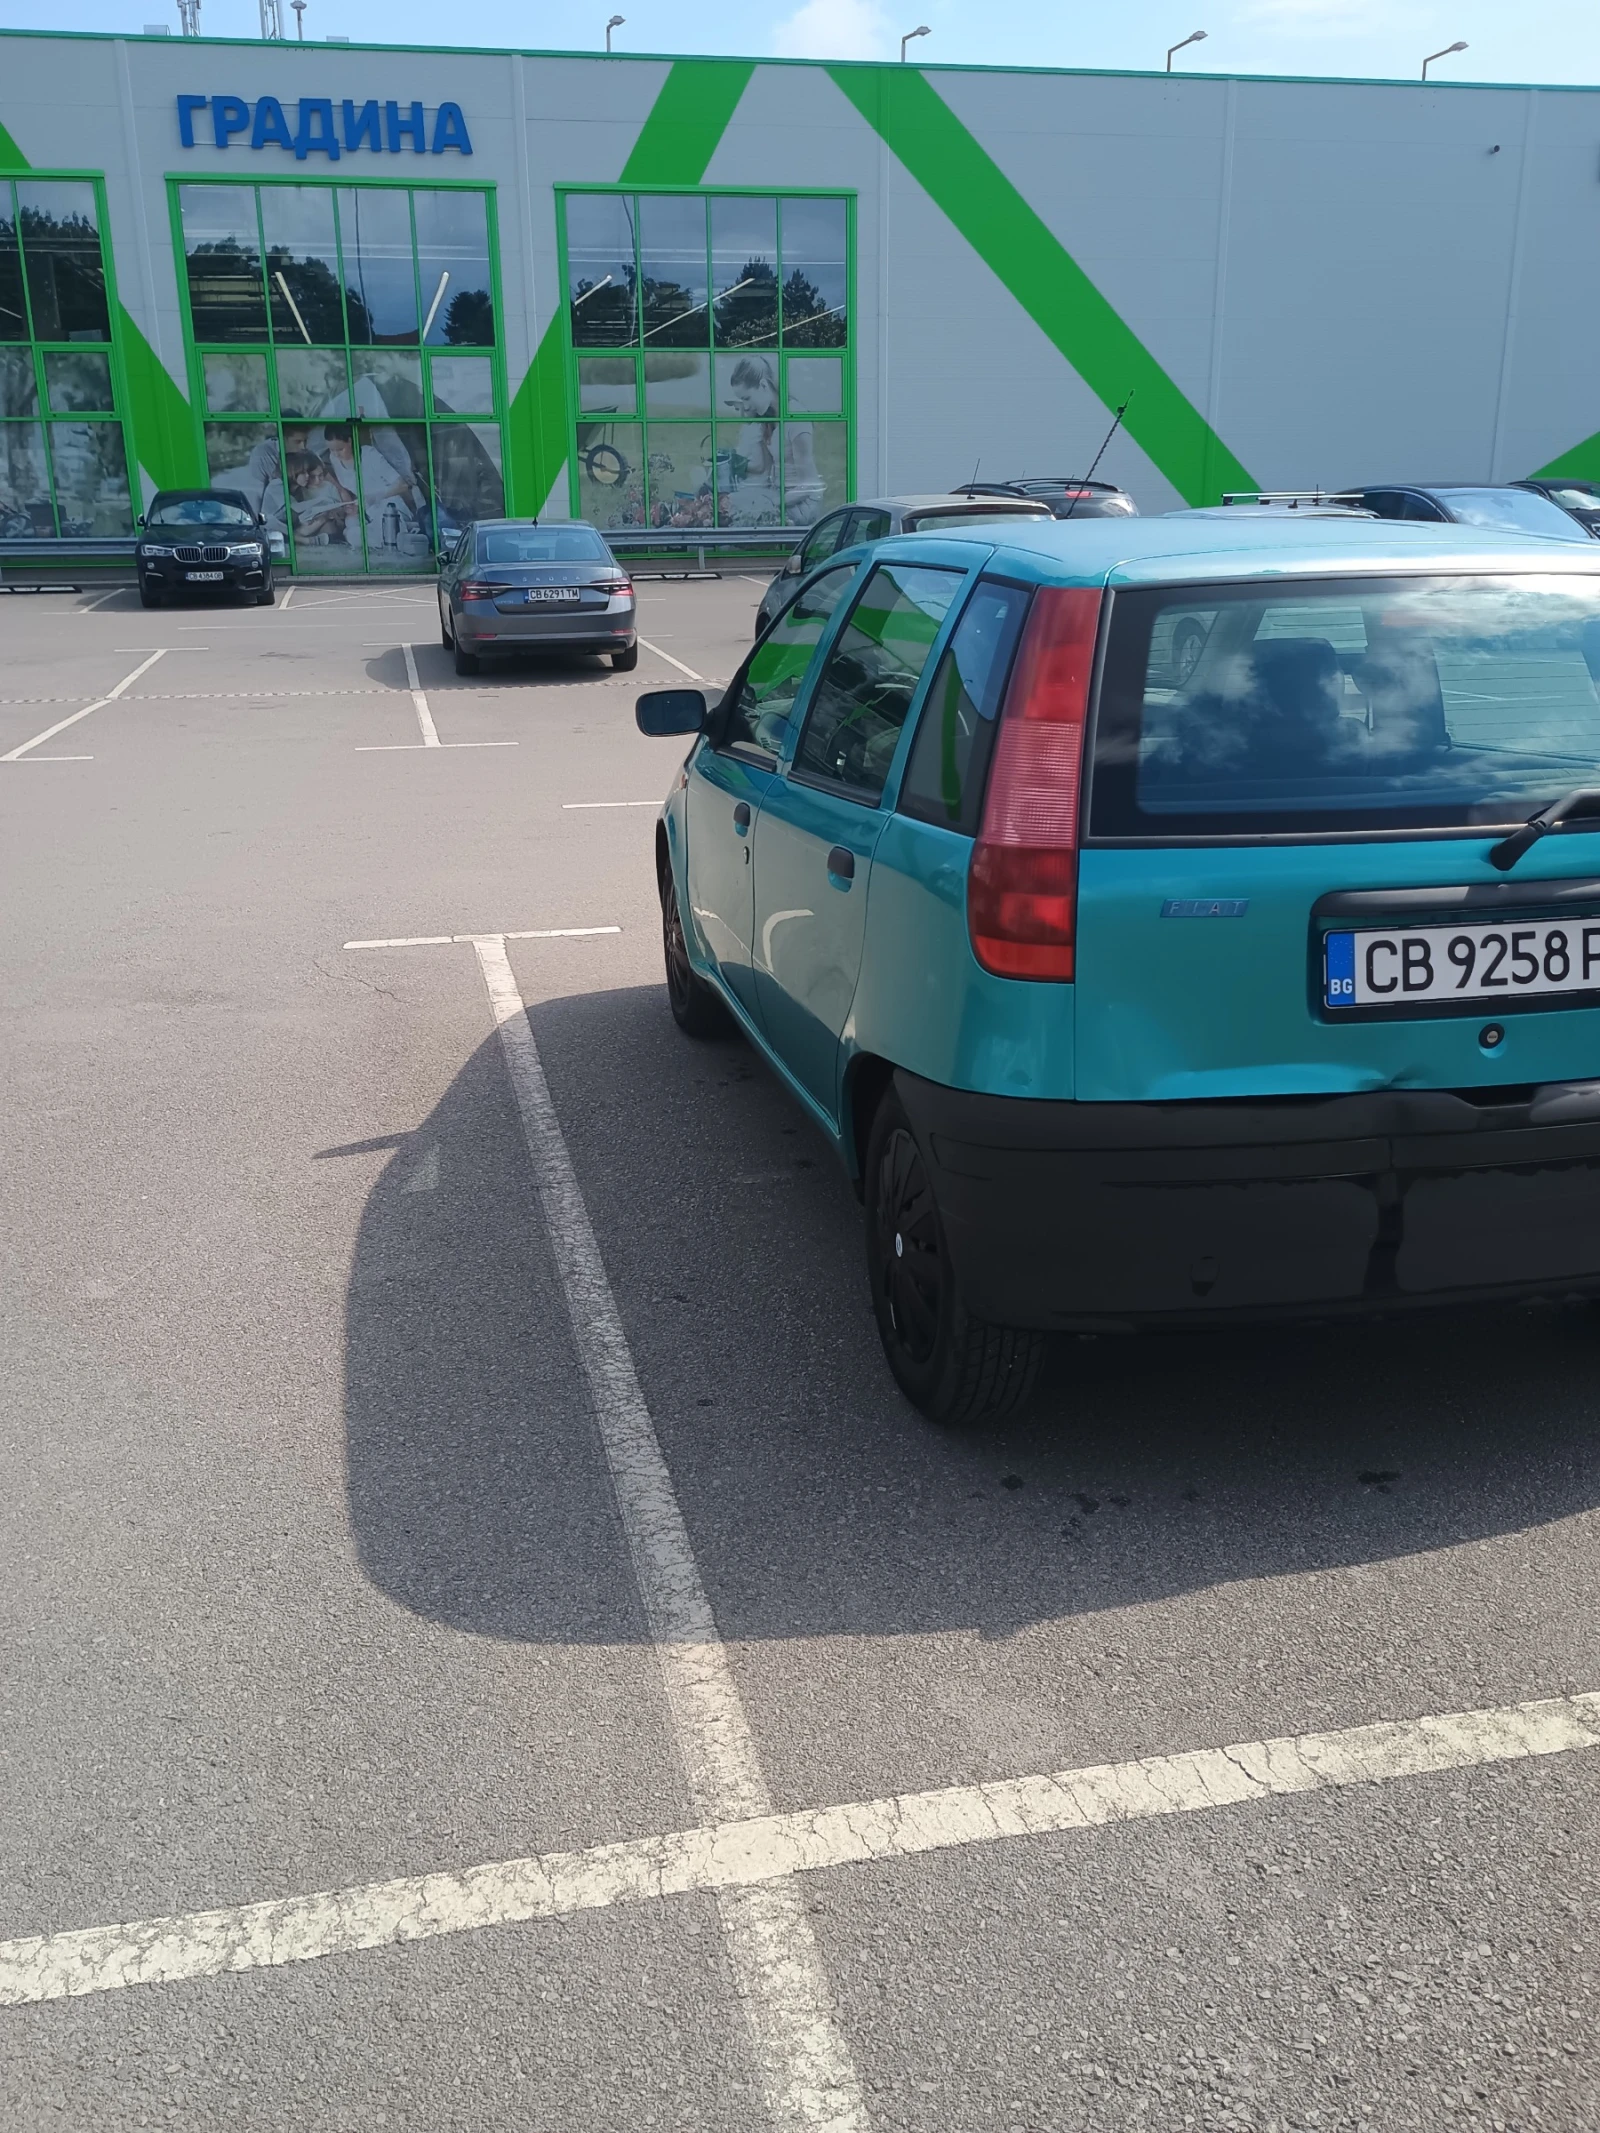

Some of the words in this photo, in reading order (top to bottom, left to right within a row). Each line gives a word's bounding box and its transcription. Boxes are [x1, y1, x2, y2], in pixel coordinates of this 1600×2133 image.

[177, 94, 473, 161] ГРАДИНА
[529, 590, 542, 599] CB
[543, 589, 565, 599] 6291
[566, 589, 579, 598] TM
[1169, 901, 1243, 914] FIAT
[1366, 938, 1433, 993] CB
[1447, 929, 1570, 988] 9258
[1330, 979, 1353, 995] BG
